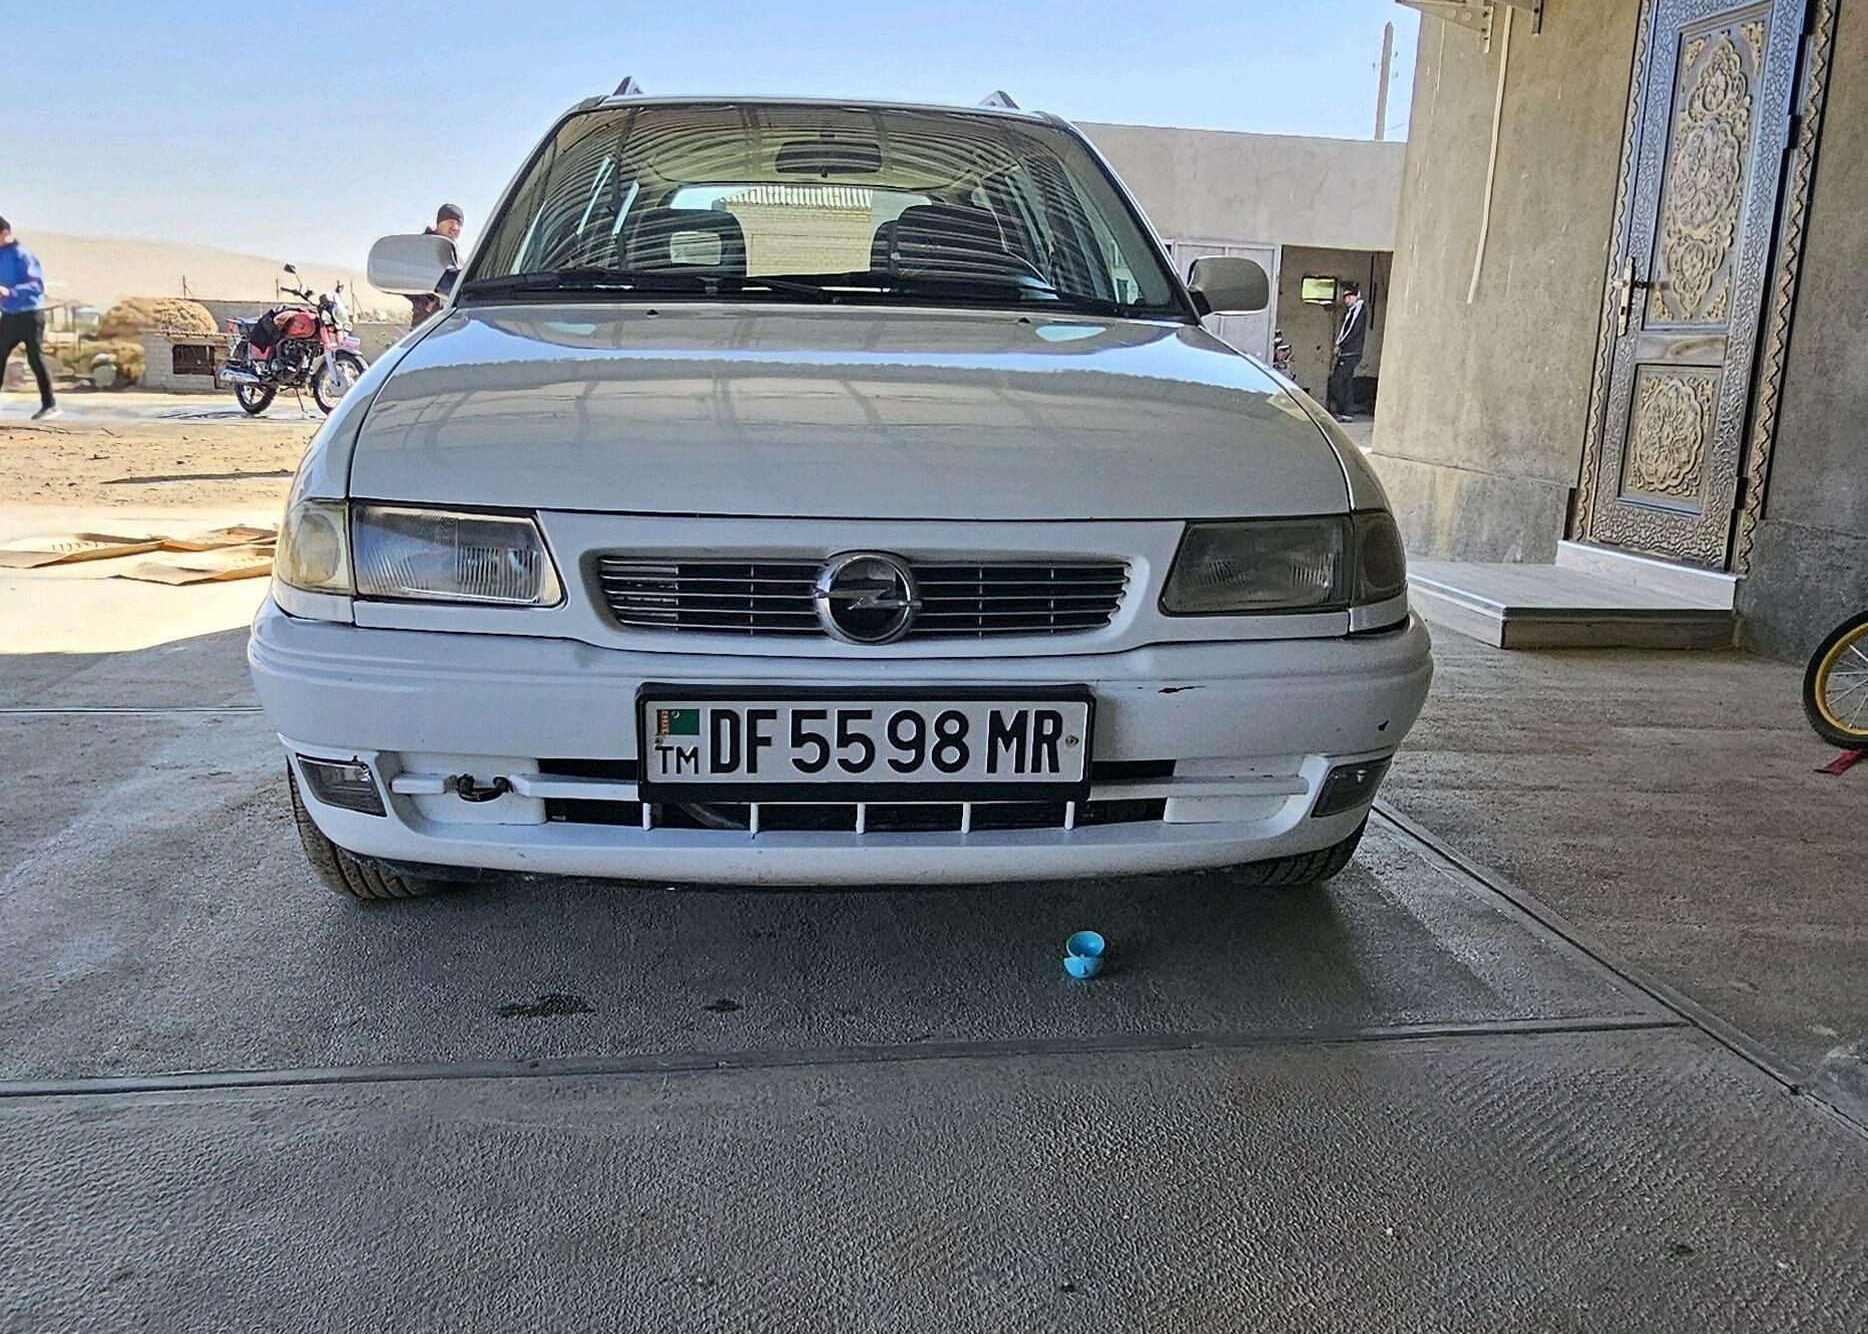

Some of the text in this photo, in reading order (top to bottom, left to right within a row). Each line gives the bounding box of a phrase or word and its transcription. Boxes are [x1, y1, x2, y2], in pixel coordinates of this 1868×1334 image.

[654, 746, 699, 775] TM
[709, 708, 1063, 774] DF 5598 MR
